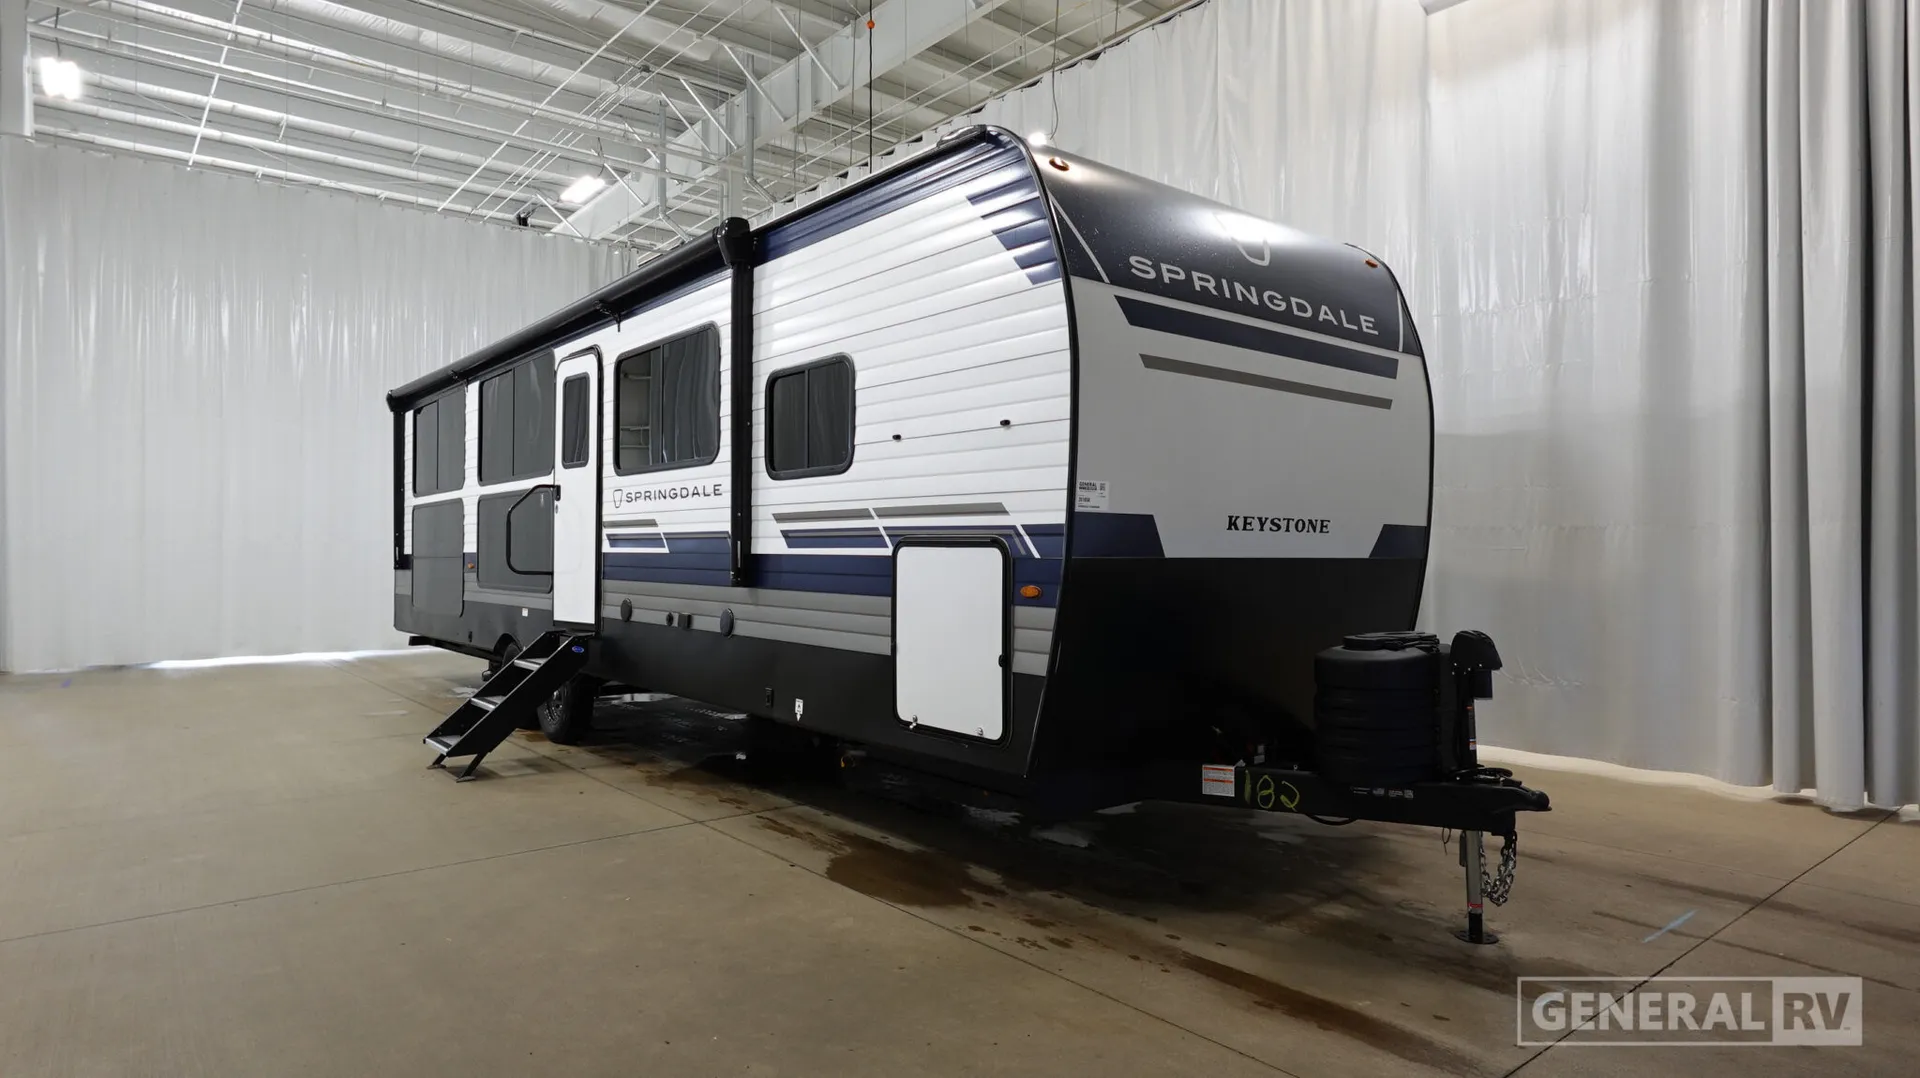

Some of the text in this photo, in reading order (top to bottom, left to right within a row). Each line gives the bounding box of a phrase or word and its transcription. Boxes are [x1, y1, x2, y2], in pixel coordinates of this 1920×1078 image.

[1129, 255, 1379, 335] SPRINGDALE
[625, 484, 722, 503] SPRINGDALE
[1226, 515, 1331, 533] KEYSTONE
[1244, 769, 1300, 812] 182
